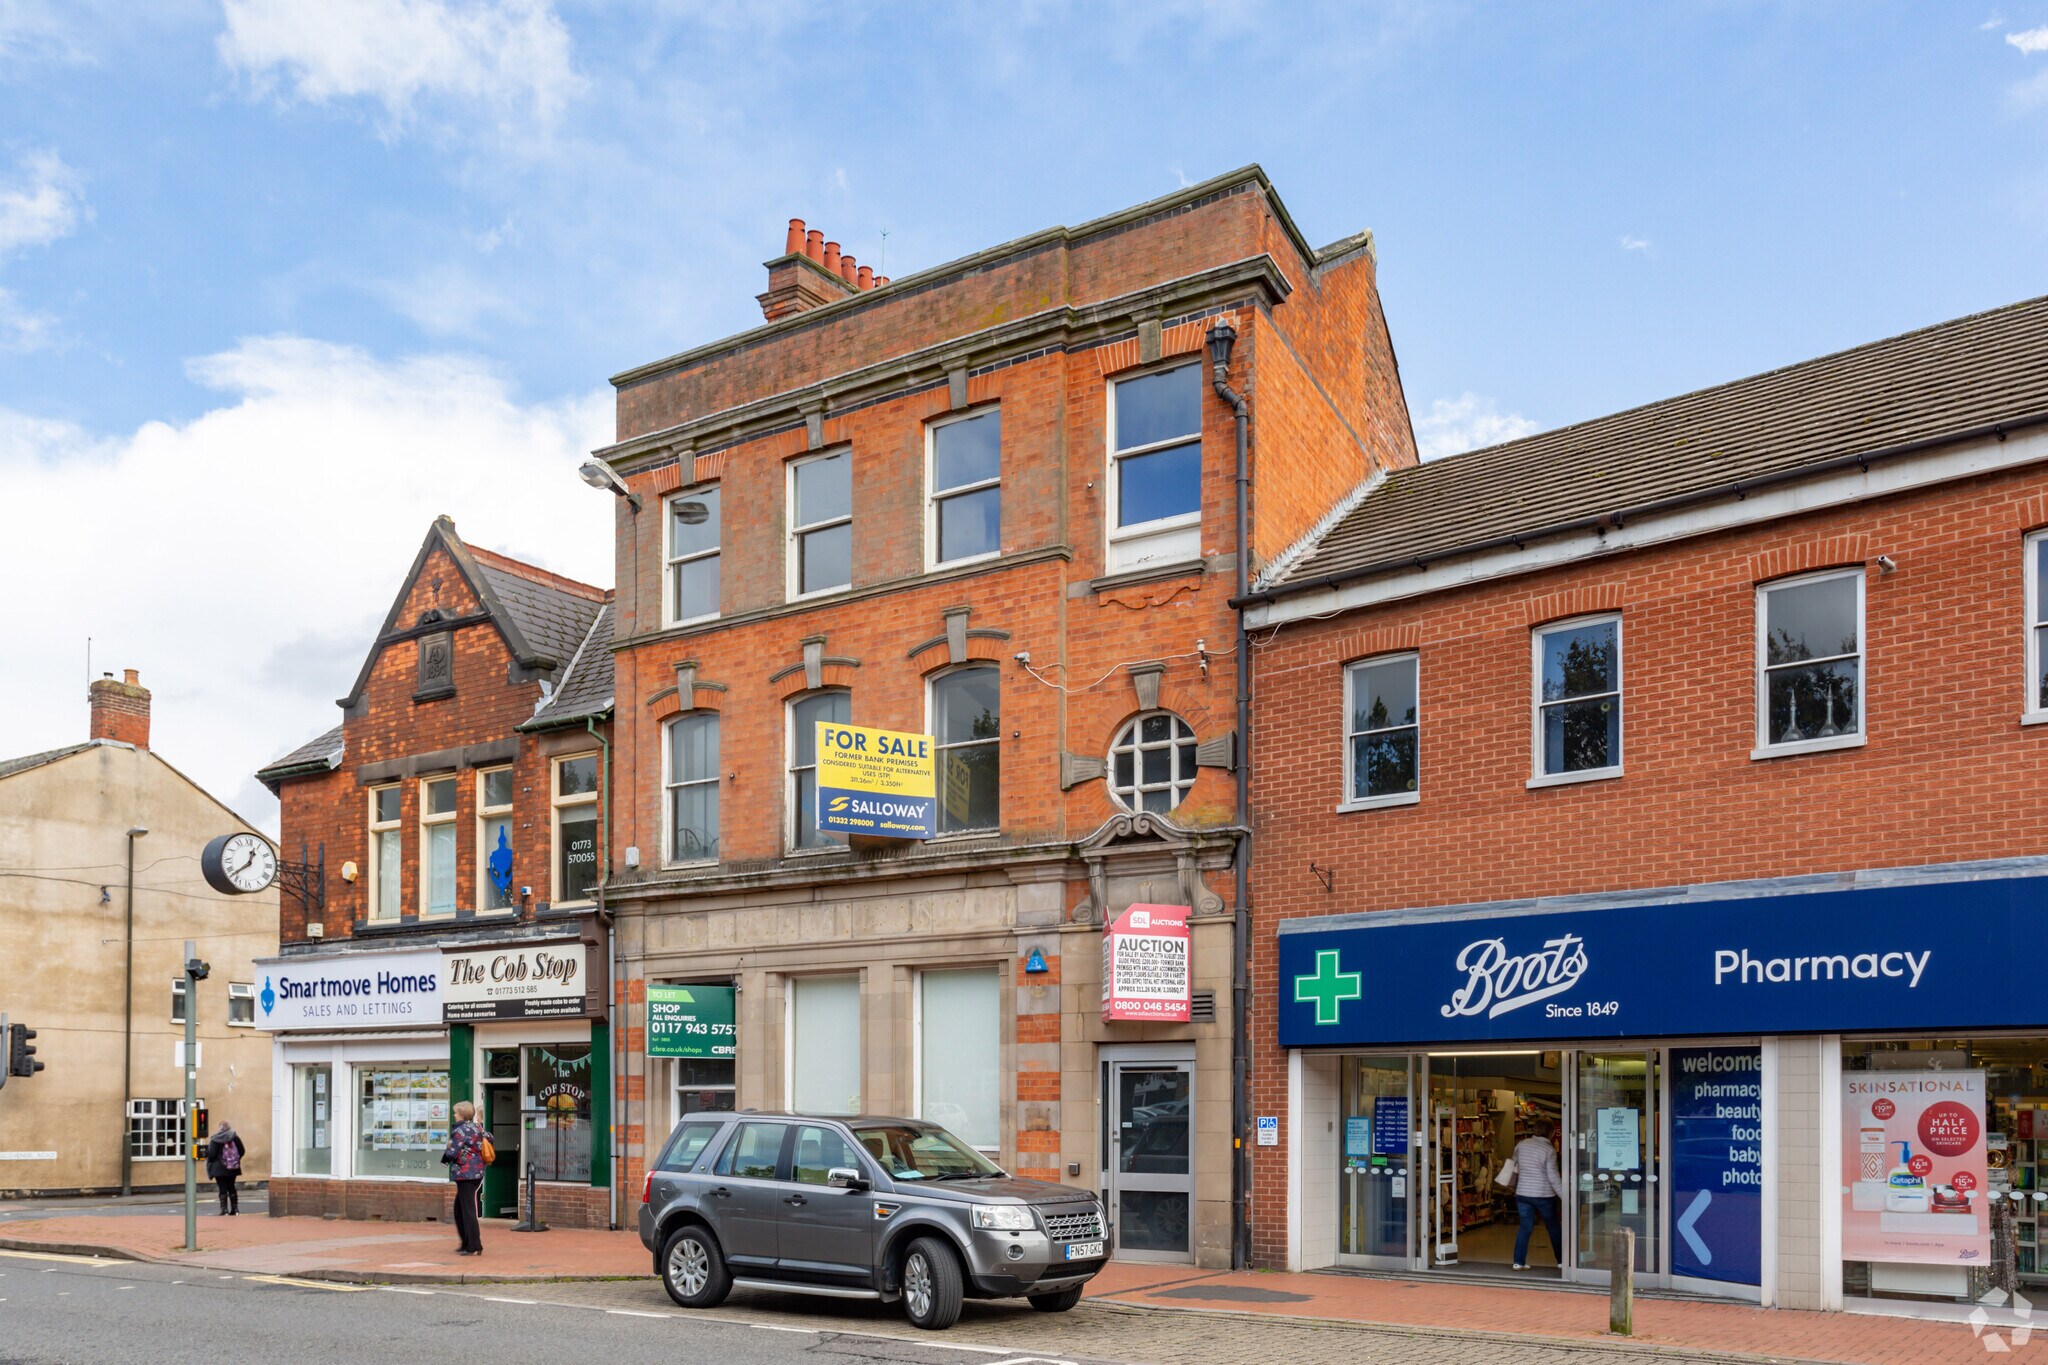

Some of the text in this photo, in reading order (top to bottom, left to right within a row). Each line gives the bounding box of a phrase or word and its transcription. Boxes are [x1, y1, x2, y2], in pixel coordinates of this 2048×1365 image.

[825, 729, 928, 758] FOR SALE
[834, 752, 862, 761] FORMER
[887, 758, 918, 767] PREMISES
[823, 759, 856, 768] CONSIDERED
[896, 768, 930, 776] ALTERNATIVE
[852, 800, 925, 818] SALLOWAY
[828, 816, 848, 824] 01332
[880, 821, 925, 831] salloway.com
[572, 840, 591, 850] 01773
[568, 852, 595, 863] 570055
[1132, 916, 1147, 924] SDL
[1118, 938, 1184, 953] AUCTION
[451, 952, 578, 985] The Cob Stop
[1715, 948, 1931, 988] Pharmacy
[1440, 932, 1588, 1020] Boots
[279, 971, 436, 999] Smartmove Homes
[495, 987, 513, 995] 01773
[303, 1002, 412, 1017] SALES AND LETTINGS
[652, 1004, 680, 1013] SHOP
[1115, 1001, 1186, 1011] 0800 046 5454
[1545, 1001, 1619, 1018] Since 1849
[652, 1022, 682, 1033] 0117
[686, 1024, 707, 1034] 943
[652, 1045, 736, 1054] cbre.co.uk/shops CBRE
[1682, 1052, 1761, 1072] welcome
[560, 1082, 585, 1100] STOP
[1849, 1081, 1974, 1093] SKINSATIONAL
[1722, 1168, 1761, 1186] photo
[1891, 1176, 1922, 1186] Cetaphil
[1071, 1245, 1088, 1256] FN57
[1958, 1249, 1979, 1259] Boots
